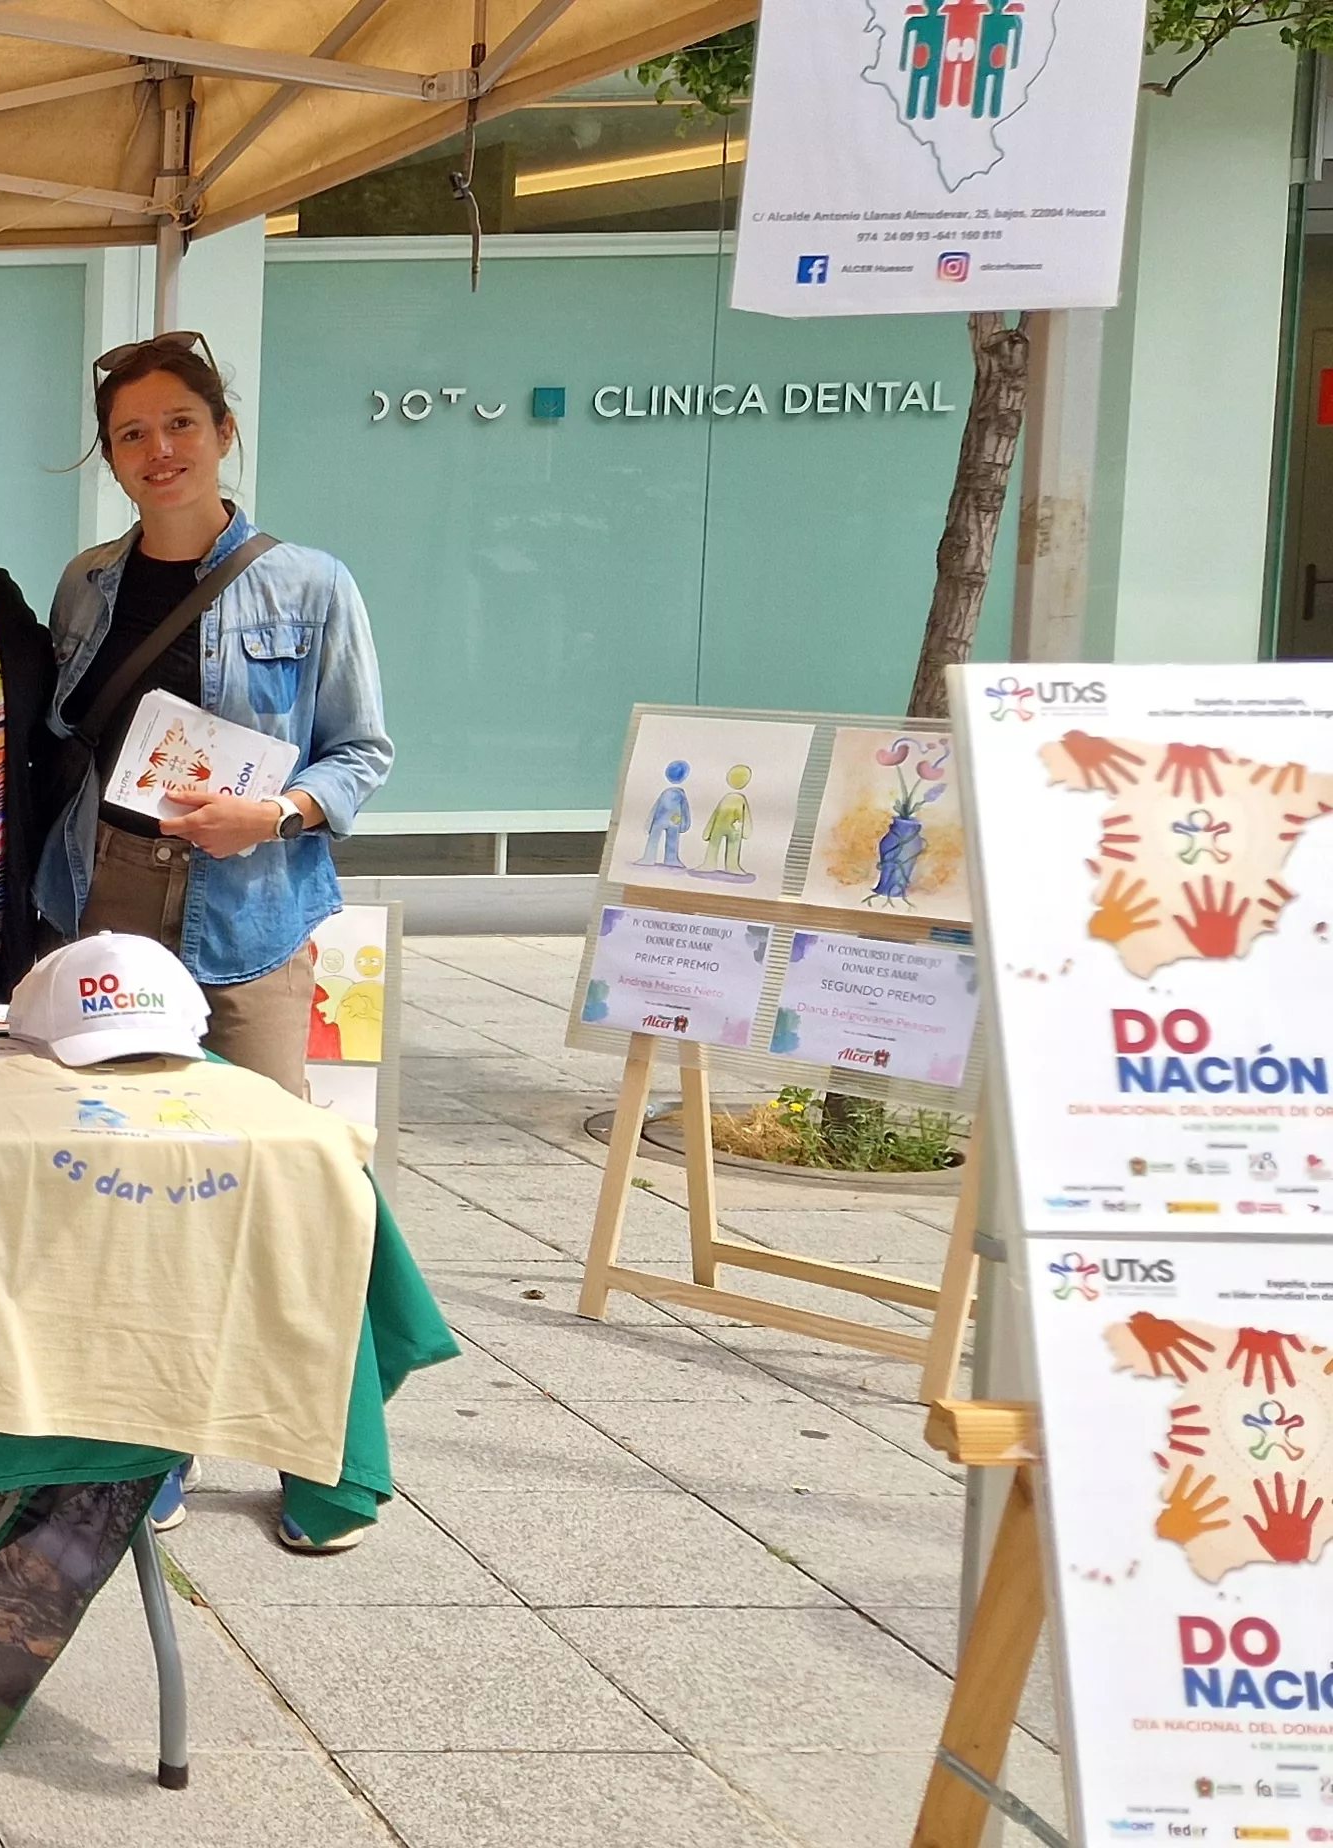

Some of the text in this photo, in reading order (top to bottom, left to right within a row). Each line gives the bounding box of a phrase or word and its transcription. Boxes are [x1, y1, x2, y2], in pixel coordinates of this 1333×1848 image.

[752, 212, 764, 222] C/
[767, 211, 810, 222] Alcalde
[813, 211, 860, 222] Antonio
[863, 211, 902, 221] Llanas
[1066, 208, 1106, 218] Huesca
[857, 232, 878, 242] 974
[883, 232, 898, 242] 24
[593, 381, 955, 418] CLINICA DENTAL
[1037, 681, 1107, 704] UTxS
[234, 762, 256, 796] CIÓN
[642, 919, 688, 933] CONCURSO
[688, 925, 702, 935] DE
[702, 926, 733, 941] DIBUJO
[646, 935, 713, 952] DONAR ES AMAR
[635, 952, 720, 972] PRIMER PREMIO
[838, 946, 890, 961] CONCURSO
[892, 952, 906, 964] DE
[907, 955, 942, 970] DIBUJO
[841, 962, 919, 982] DONAR ES AMAR
[79, 974, 119, 997] DO
[618, 975, 724, 998] Andrea Marcos Nieto
[820, 979, 937, 1006] SEGUNDO PREMIO
[82, 987, 165, 1013] NACIÓN
[797, 1002, 829, 1017] Diana
[641, 1014, 674, 1029] Alcer
[1110, 1008, 1211, 1055] DO
[837, 1047, 874, 1064] Alcer
[1115, 1043, 1329, 1094] NACIÓN
[52, 1149, 239, 1205] es dar vida
[1101, 1258, 1175, 1284] UTxS
[1178, 1616, 1281, 1668] DO
[1182, 1662, 1333, 1711] NACI
[1164, 1720, 1243, 1733] NACIONAL
[1249, 1722, 1277, 1734] DEL
